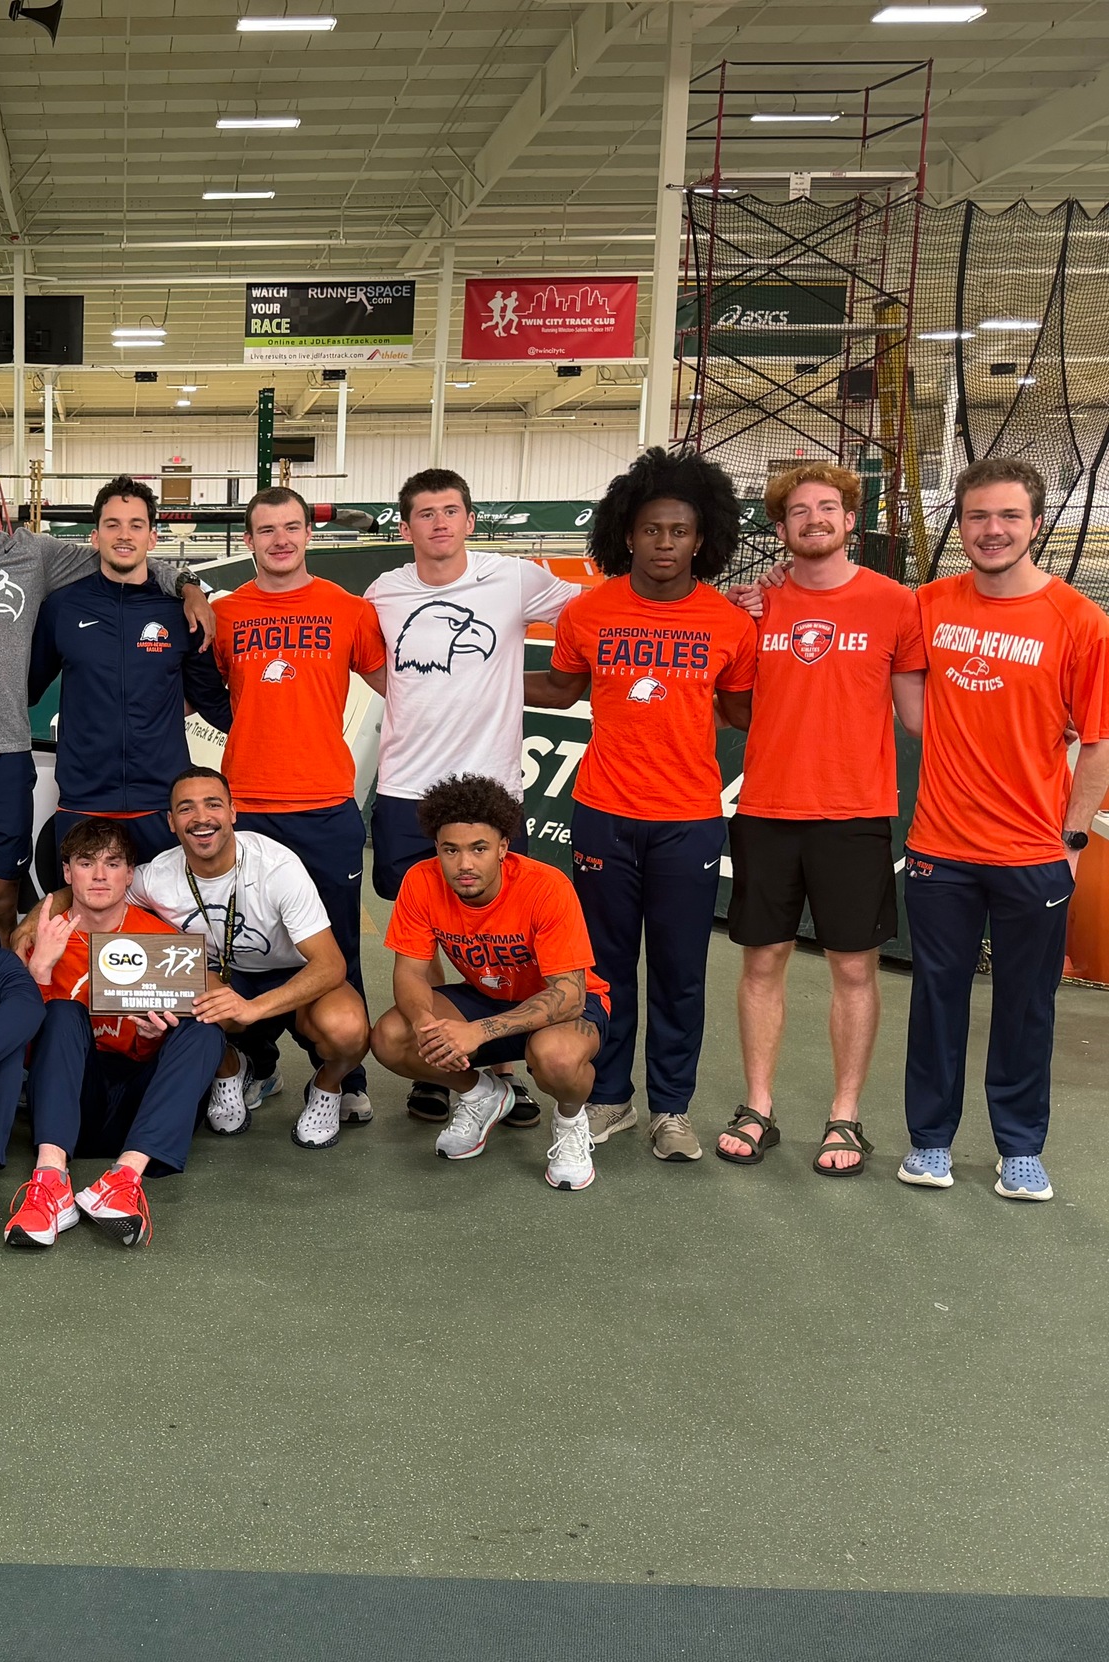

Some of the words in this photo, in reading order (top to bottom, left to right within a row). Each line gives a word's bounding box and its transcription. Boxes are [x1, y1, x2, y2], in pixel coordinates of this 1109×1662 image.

[251, 287, 288, 298] WATCH
[308, 285, 412, 299] RUNNERSPACE
[251, 303, 281, 315] YOUR
[250, 318, 291, 334] RACE
[521, 318, 543, 326] TWIN
[545, 318, 564, 326] CITY
[565, 317, 592, 326] TRACK
[594, 317, 616, 325] CLUB
[267, 338, 296, 346] Online
[310, 338, 391, 346] JDLFastTrack.com
[265, 352, 287, 360] results
[527, 346, 566, 356] @twincitytc
[232, 615, 333, 630] CARSON-NEWMAN
[233, 626, 332, 655] EAGLES
[598, 627, 712, 643] CARSON-NEWMAN
[762, 633, 789, 652] EAG
[837, 632, 869, 651] LES
[932, 622, 1045, 667] CARSON-NEWMAN
[596, 639, 710, 670] EAGLES
[944, 666, 1005, 692] ATHLETICS
[538, 820, 573, 845] Fie
[108, 952, 144, 967] SAC
[103, 989, 116, 997] SAC
[155, 990, 175, 998] TRACK
[180, 990, 195, 998] FIELD
[121, 997, 162, 1009] RUNNER
[163, 998, 178, 1009] UP
